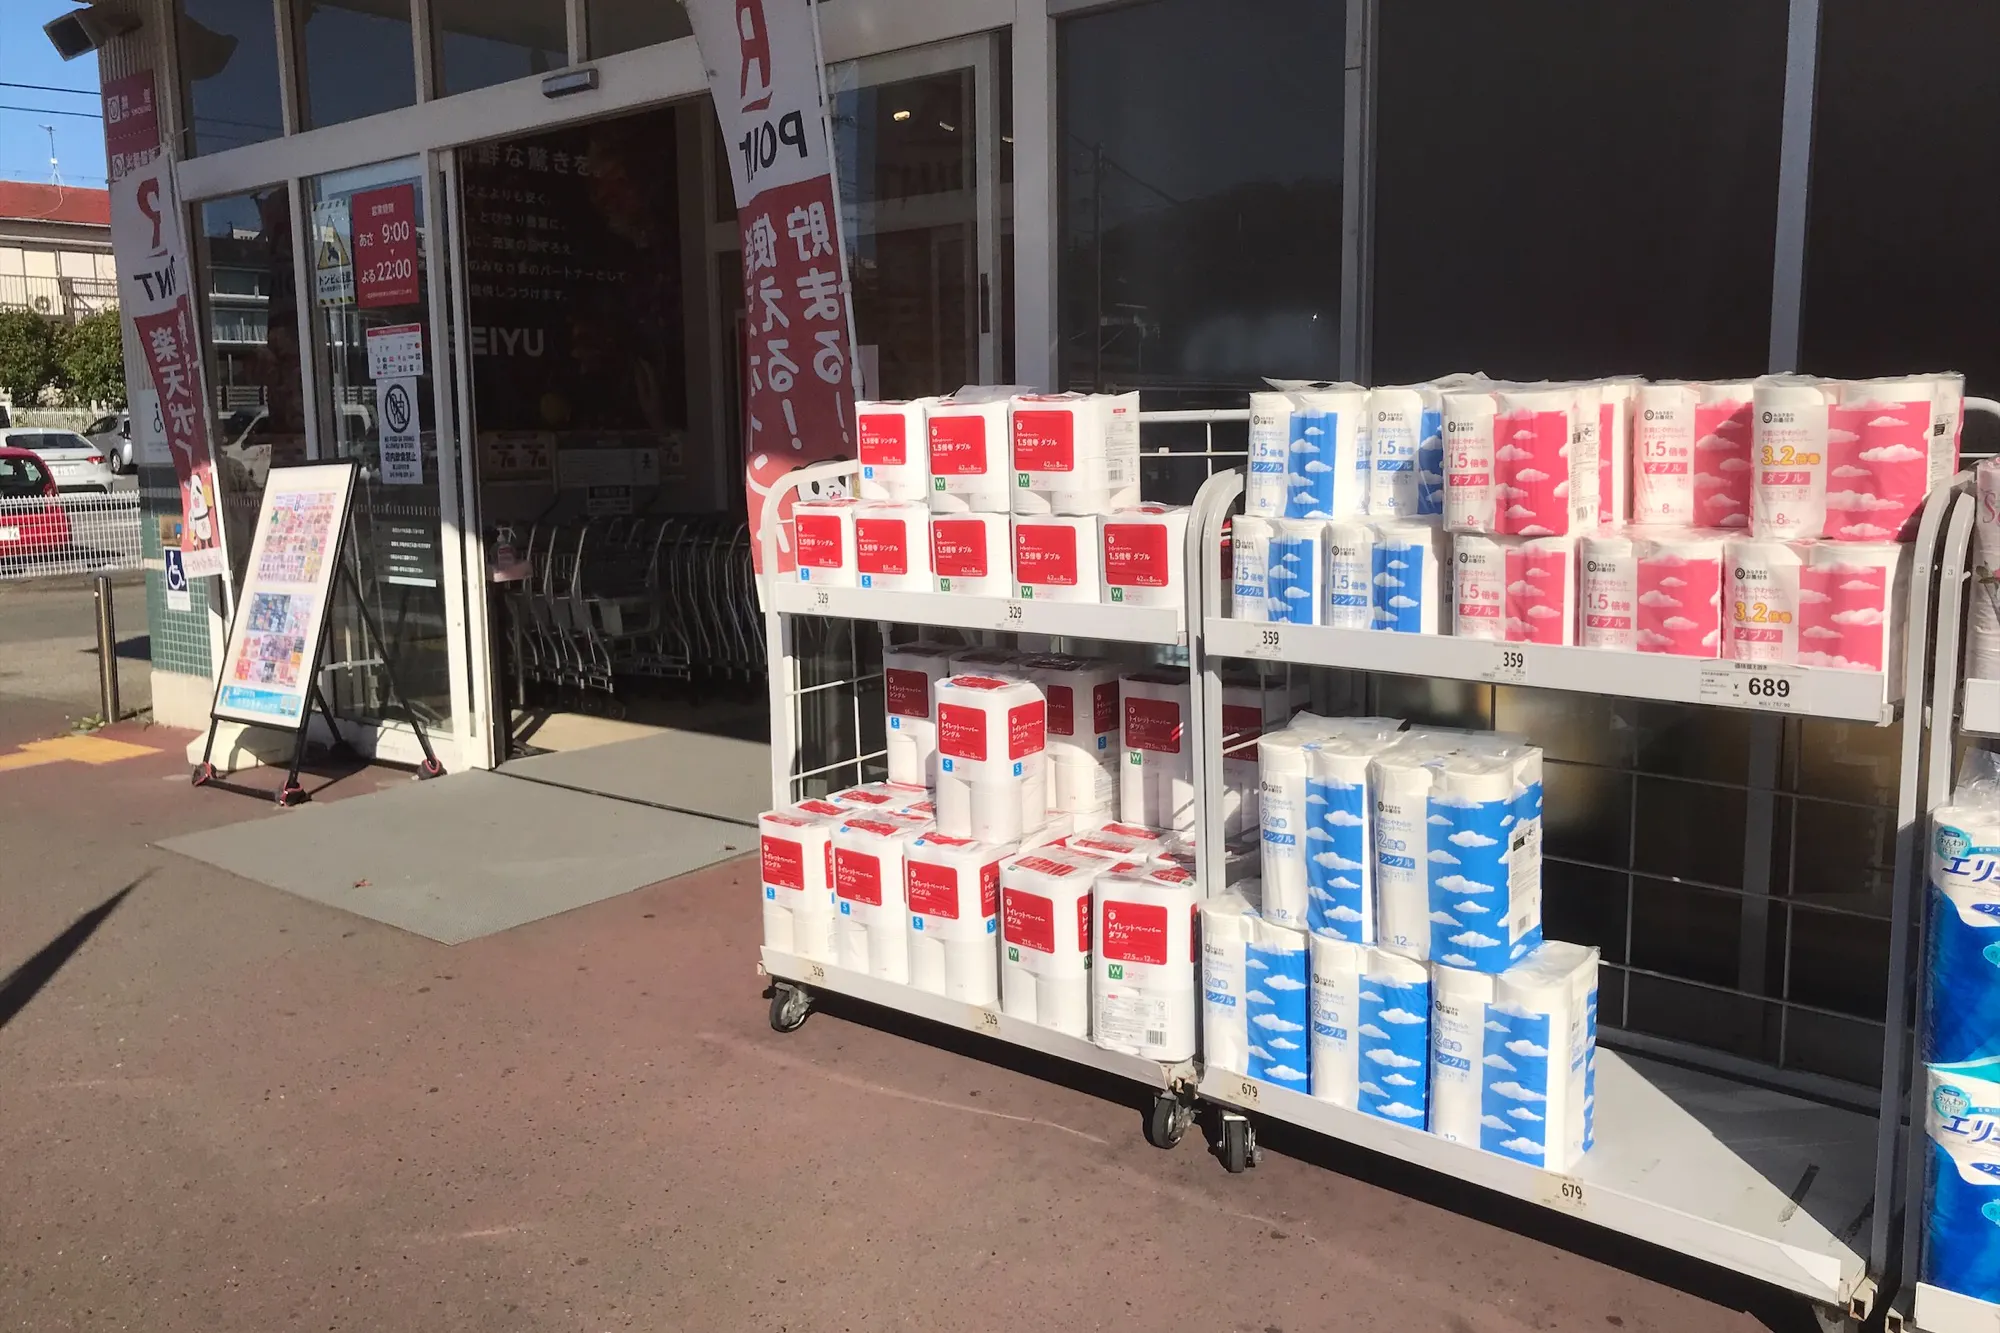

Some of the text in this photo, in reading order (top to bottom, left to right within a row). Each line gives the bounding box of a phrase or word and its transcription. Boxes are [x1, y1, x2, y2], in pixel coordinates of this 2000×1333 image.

[358, 220, 410, 247] あさ 9:00
[361, 258, 412, 284] よる 22:00
[470, 326, 544, 357] EIYU
[1252, 443, 1284, 458] 1.5倍巻
[1378, 440, 1413, 455] 1.5倍巻
[1644, 441, 1688, 457] 1.5倍巻
[1449, 453, 1488, 468] 1.5倍巻
[1760, 445, 1820, 465] 3.2倍巻
[1252, 463, 1283, 472] シングル
[1378, 461, 1412, 470] シングル
[1649, 464, 1682, 473] ダブル
[936, 478, 944, 486] W
[1020, 474, 1028, 483] W
[1453, 475, 1484, 484] ダブル
[1767, 473, 1804, 483] ダブル
[1235, 567, 1264, 582] 1.5倍巻
[1332, 575, 1367, 590] 1.5倍巻
[1022, 587, 1031, 595] W
[1112, 589, 1121, 597] W
[1236, 586, 1262, 595] シングル
[1460, 584, 1499, 600] 1.5倍巻
[818, 593, 828, 604] 329
[1332, 595, 1366, 605] シングル
[1587, 594, 1630, 611] 1.5倍巻
[1009, 607, 1022, 618] 329
[1463, 606, 1494, 615] ダブル
[1734, 602, 1792, 624] 3.2倍巻
[1591, 618, 1624, 626] ダブル
[1262, 631, 1279, 645] 359
[1739, 629, 1776, 640] ダブル
[1503, 652, 1524, 668] 359
[1748, 678, 1790, 697] 689
[1129, 716, 1171, 725] トイレットペーパー
[941, 722, 979, 733] トイレットペーパー
[1012, 720, 1043, 733] トイレットペーパー
[942, 730, 960, 738] シングル
[1012, 732, 1028, 741] シングル
[1016, 765, 1020, 773] S
[1264, 830, 1294, 843] シングル
[1378, 831, 1406, 851] 2倍巻
[764, 853, 796, 864] トイレットペーパー
[1380, 855, 1412, 867] シングル
[838, 866, 873, 878] トイレットペーパー
[838, 874, 856, 883] シングル
[911, 880, 950, 891] トイレットペーパー
[1007, 908, 1046, 922] トイレットペーパー
[1007, 916, 1022, 925] ダブル
[1108, 922, 1161, 933] トイレットペーパー
[1010, 949, 1017, 957] W
[1110, 965, 1121, 974] W
[1206, 992, 1234, 1005] シングル
[984, 1013, 998, 1025] 329
[1315, 1023, 1345, 1039] シングル
[1437, 1054, 1467, 1069] シングル
[1242, 1083, 1258, 1097] 679
[1562, 1184, 1582, 1199] 679
